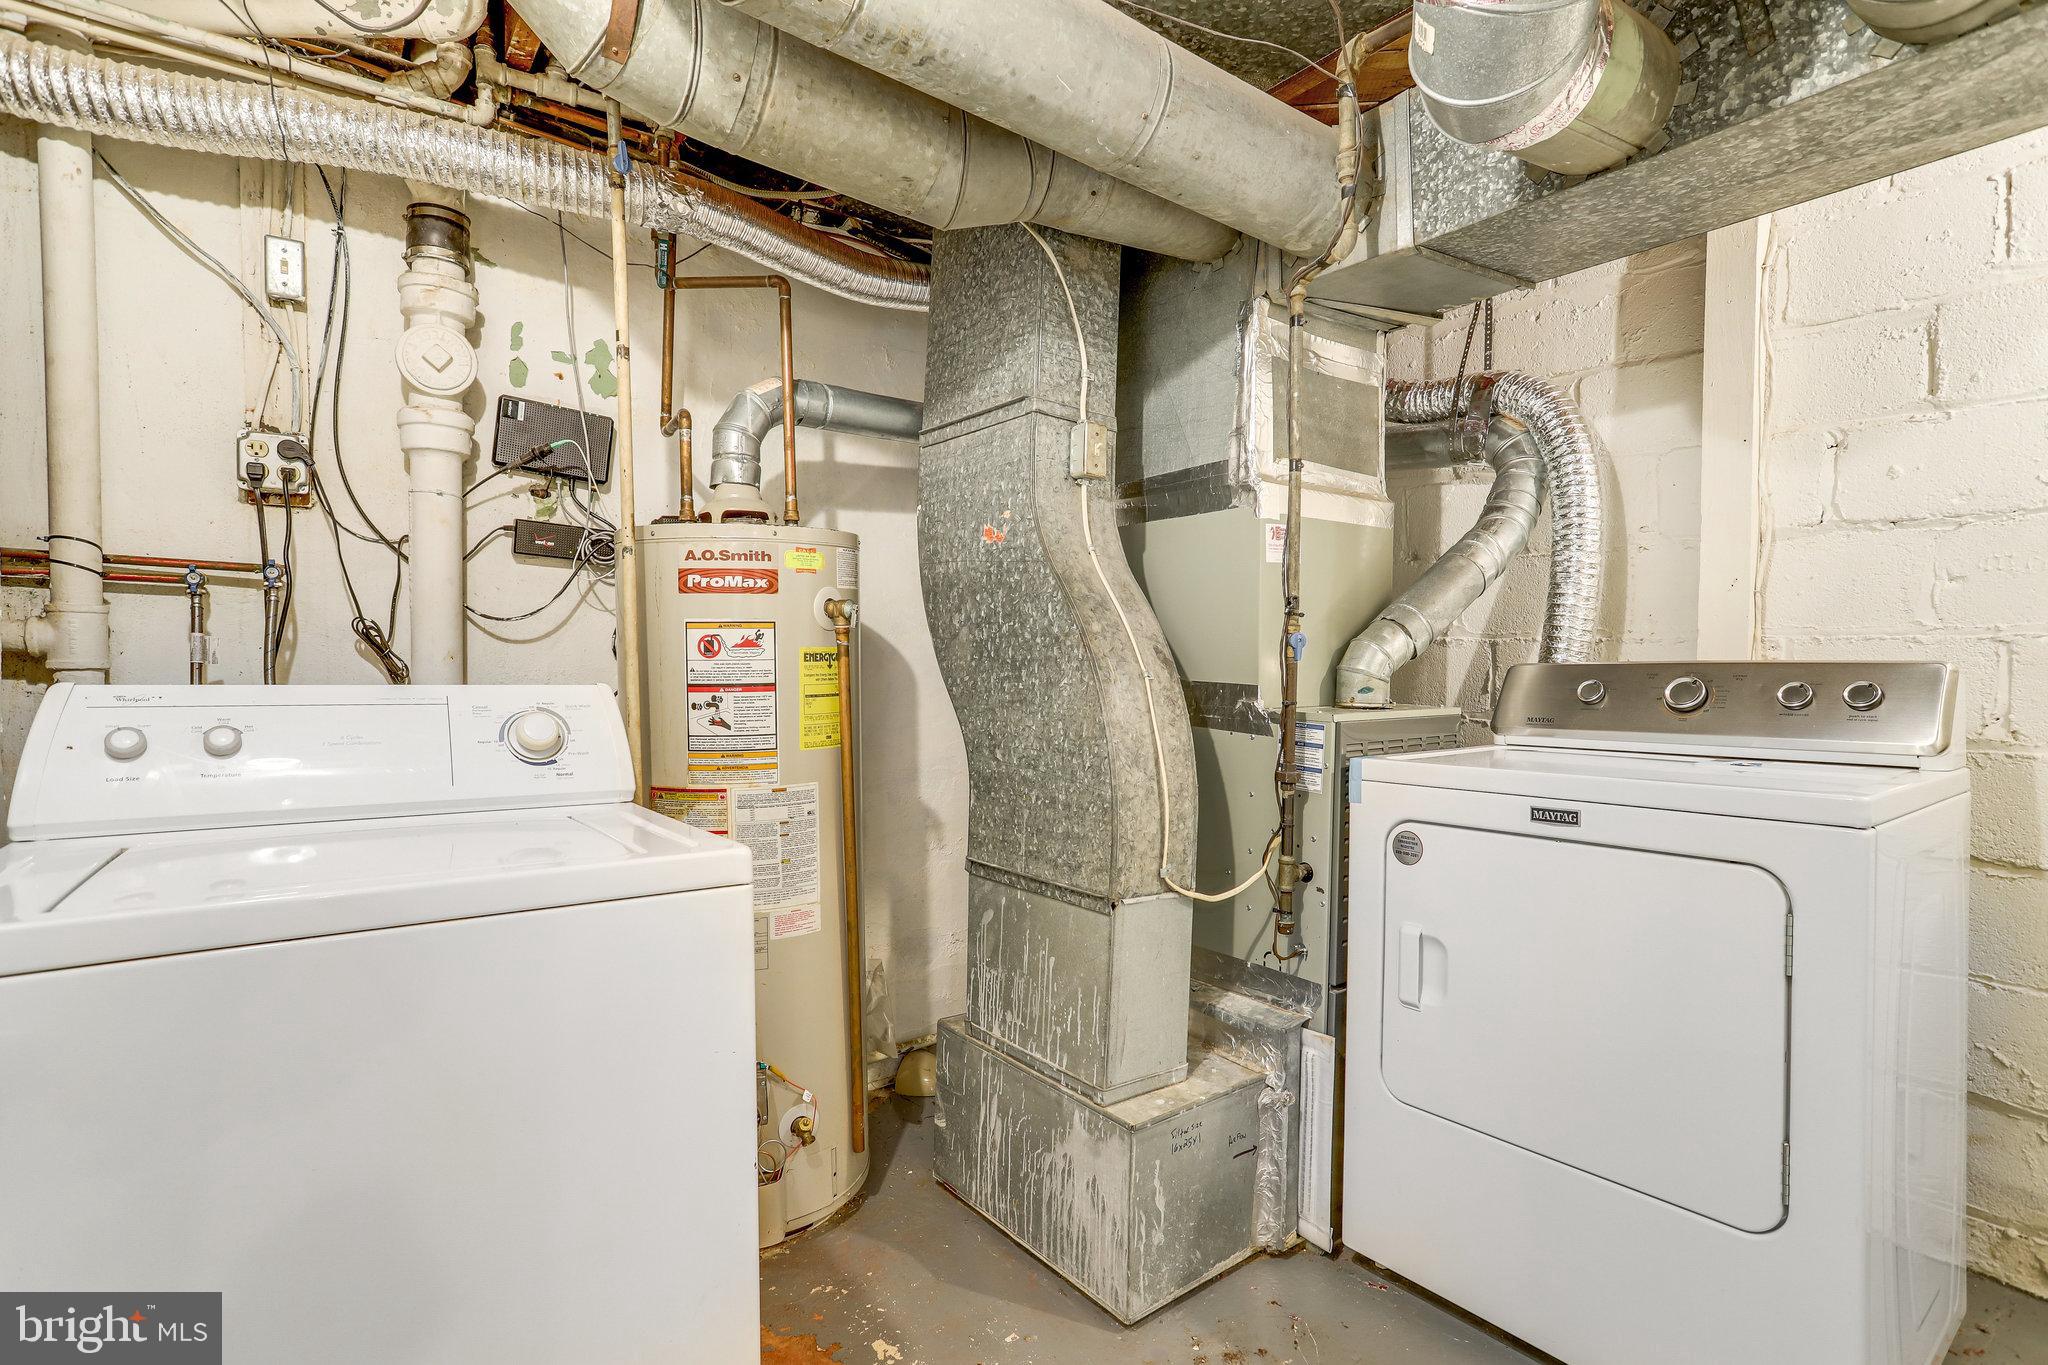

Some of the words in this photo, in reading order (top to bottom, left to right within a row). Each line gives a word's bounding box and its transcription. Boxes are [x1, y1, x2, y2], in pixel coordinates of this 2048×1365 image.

[687, 574, 768, 588] ProMax
[804, 652, 838, 662] ENERGYG
[1533, 810, 1577, 823] MAYTAG
